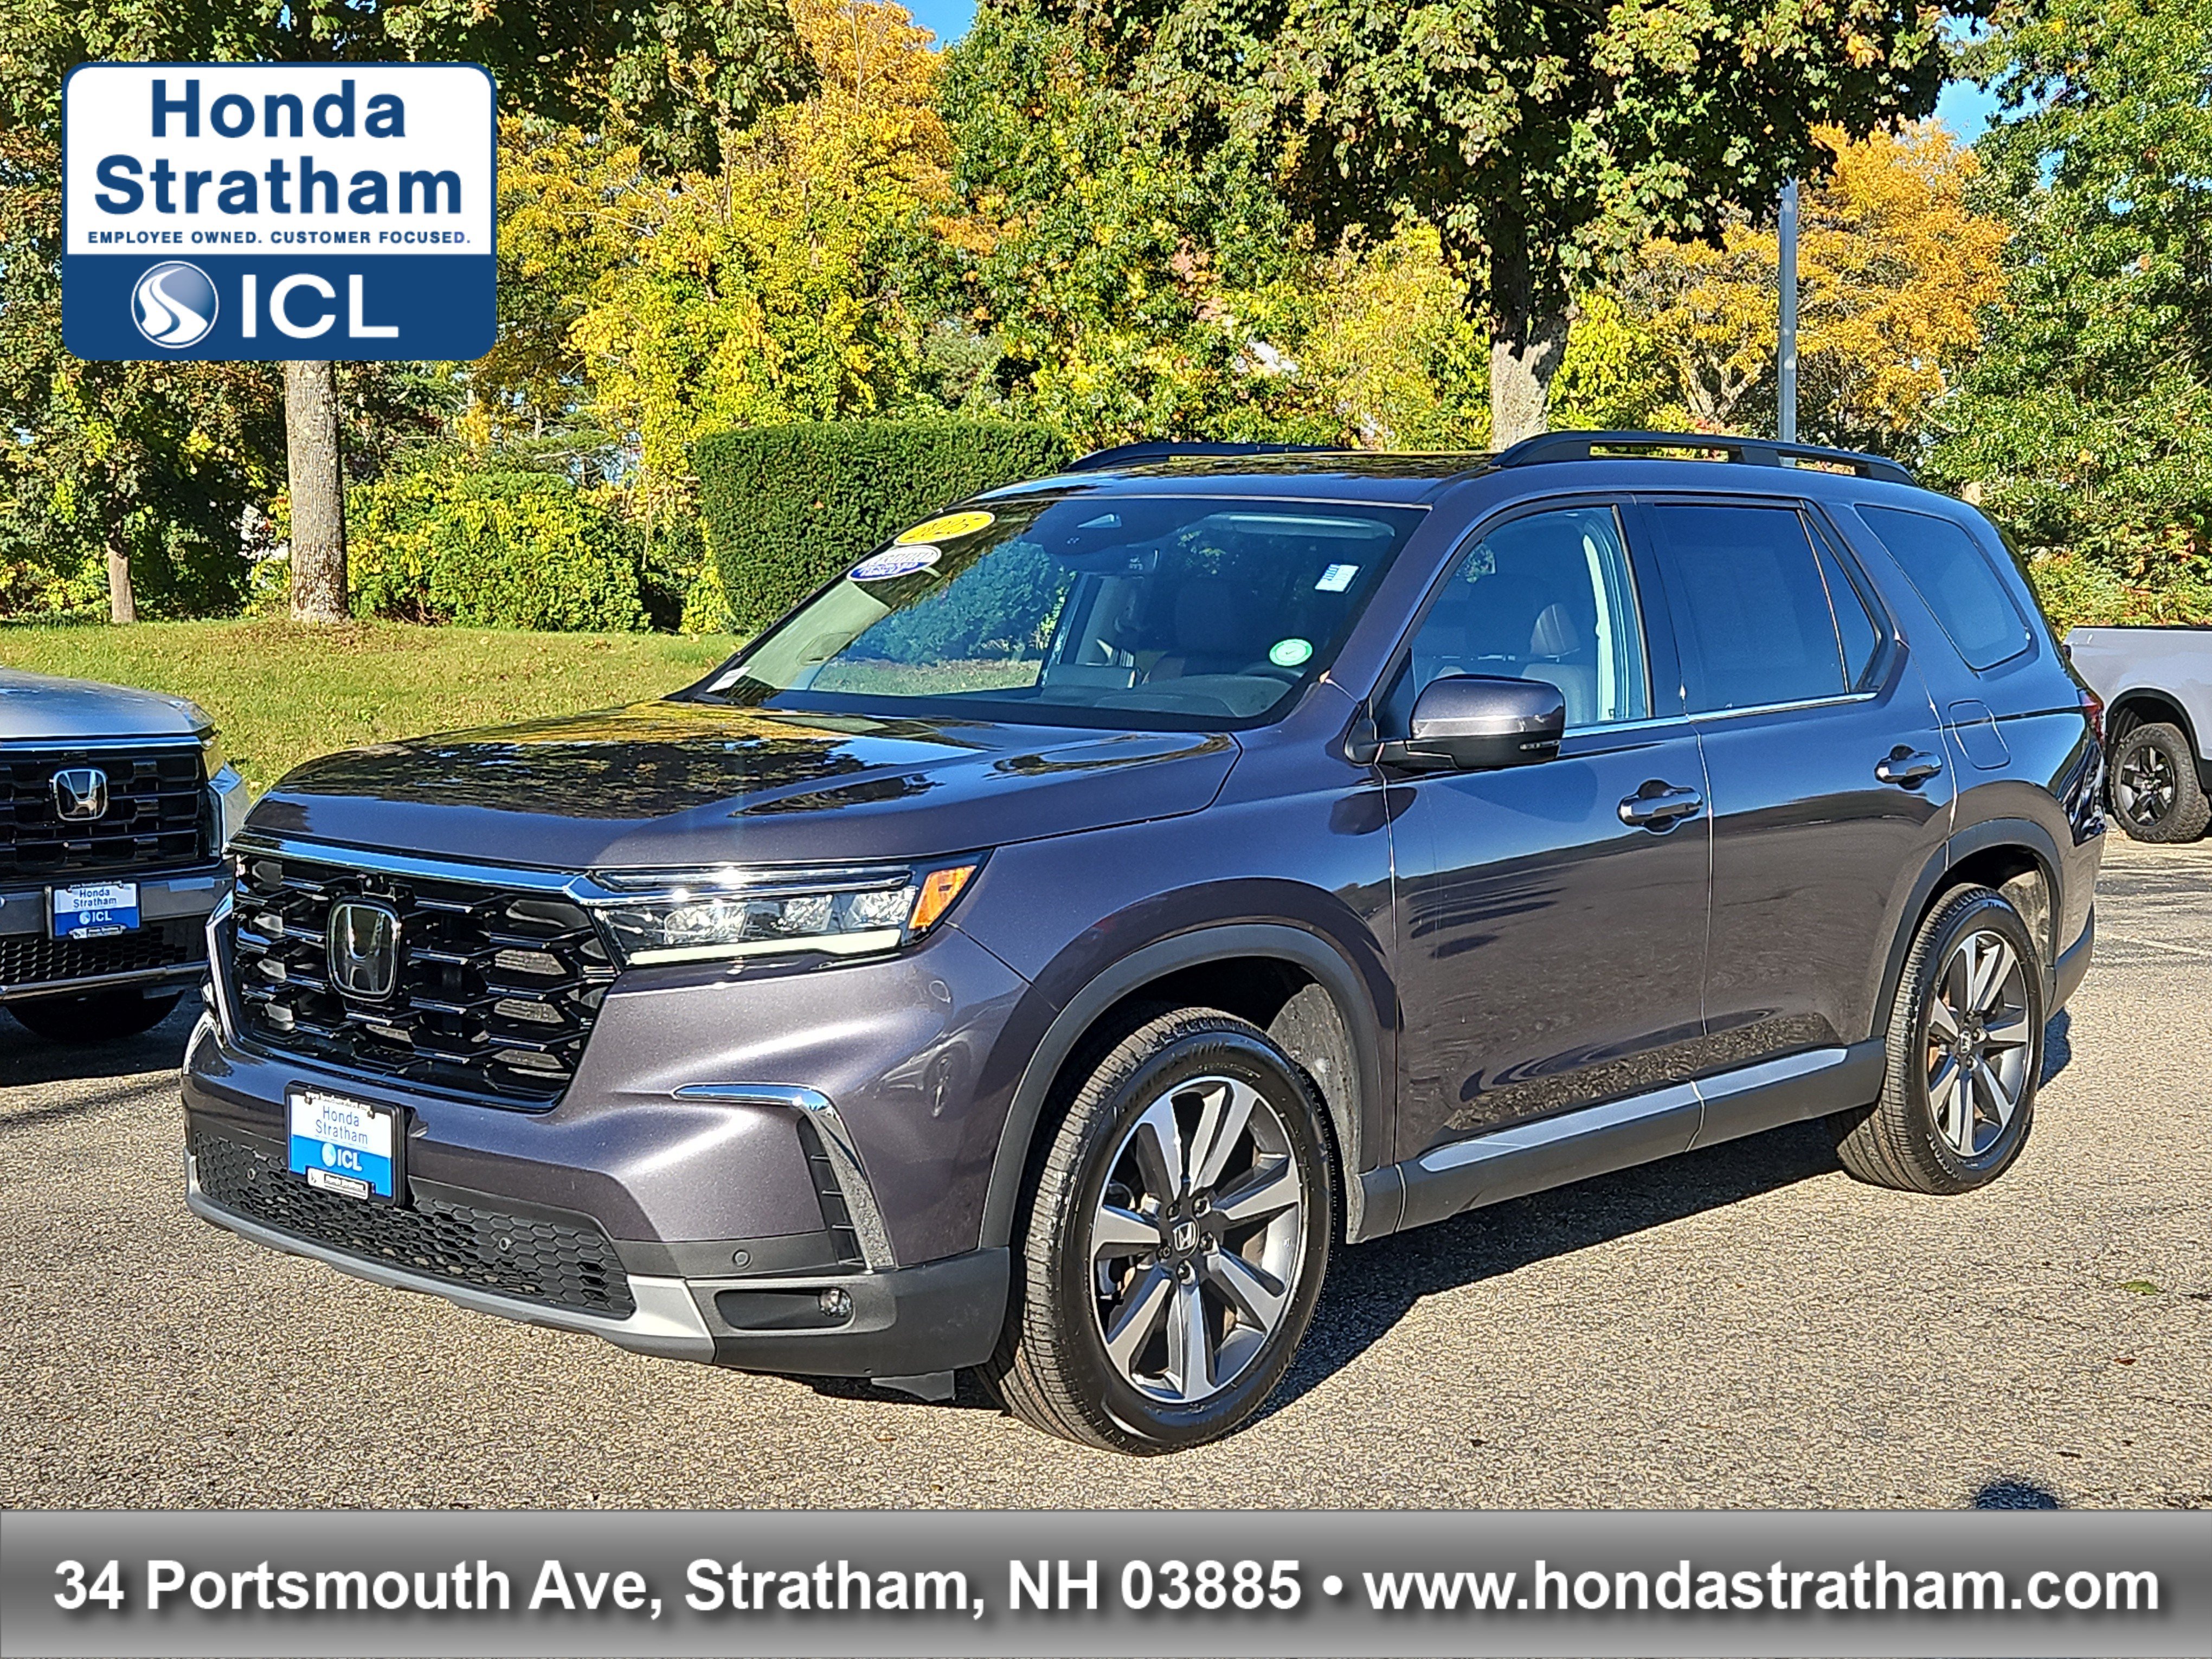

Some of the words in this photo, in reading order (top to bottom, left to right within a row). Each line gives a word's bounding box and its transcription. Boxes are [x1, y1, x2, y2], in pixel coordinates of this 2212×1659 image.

[80, 889, 111, 898] Honda
[73, 898, 117, 908] Stratham
[92, 911, 112, 922] ICL
[323, 1105, 359, 1127] Honda
[315, 1119, 368, 1145] Stratham
[337, 1149, 363, 1172] ICL
